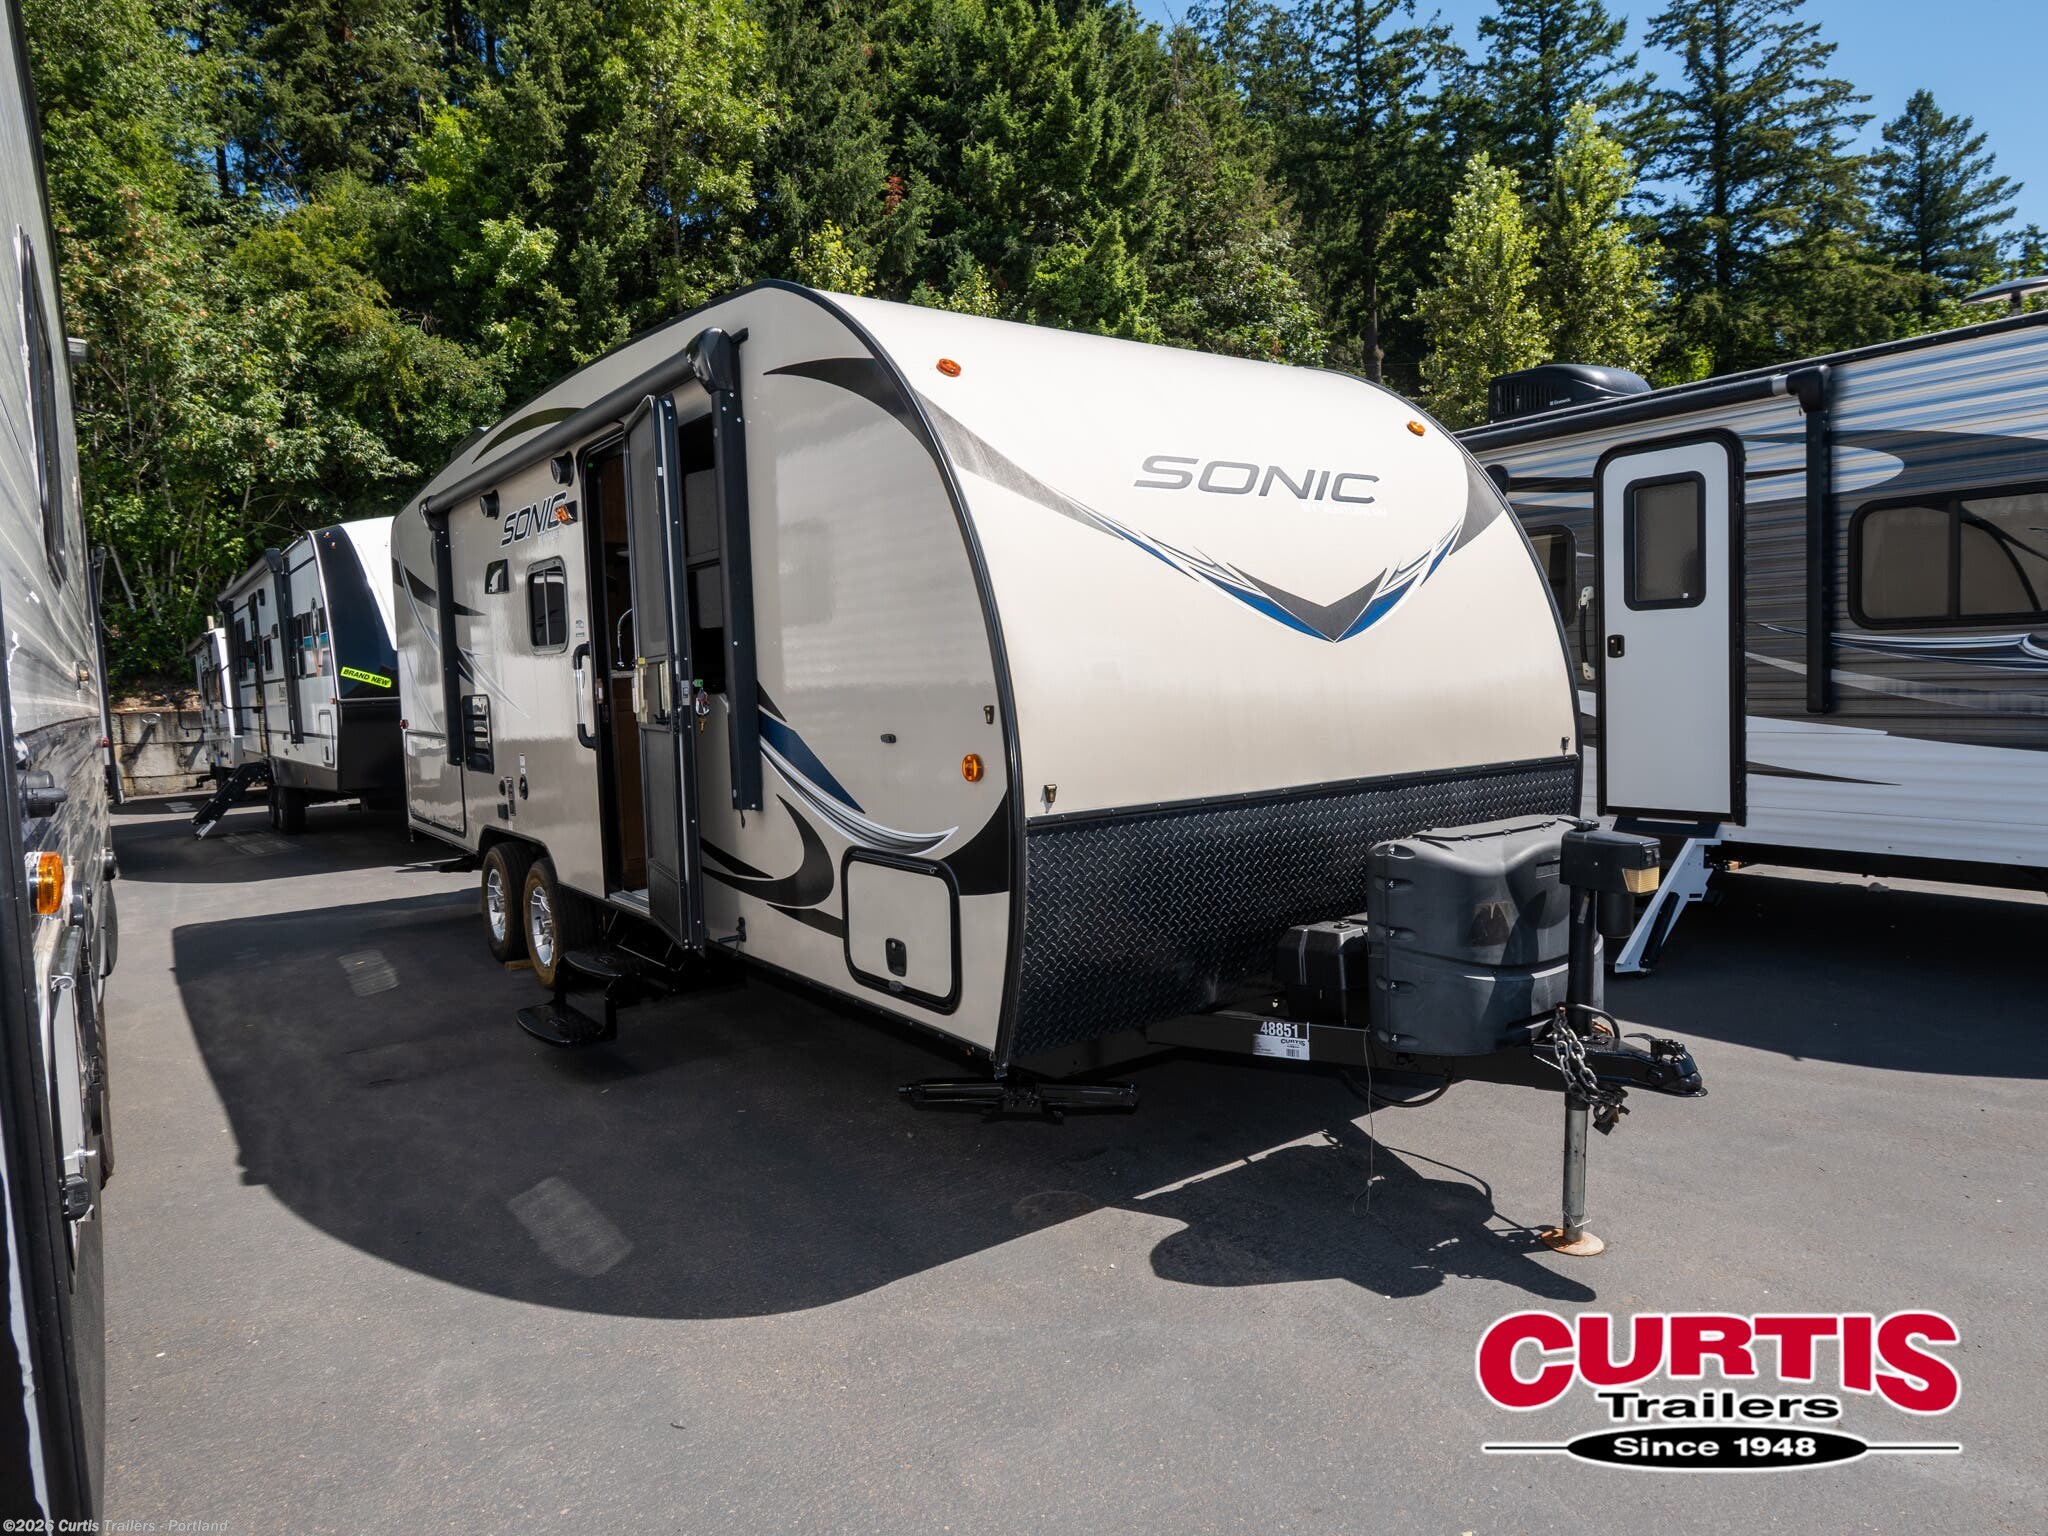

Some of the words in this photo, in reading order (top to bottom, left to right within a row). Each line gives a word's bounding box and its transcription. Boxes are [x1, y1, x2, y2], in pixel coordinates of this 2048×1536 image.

[1133, 455, 1380, 504] SONIC
[500, 491, 567, 547] SONIC
[343, 669, 370, 680] BRAND
[371, 676, 389, 686] NEW
[1260, 1021, 1298, 1038] 48851
